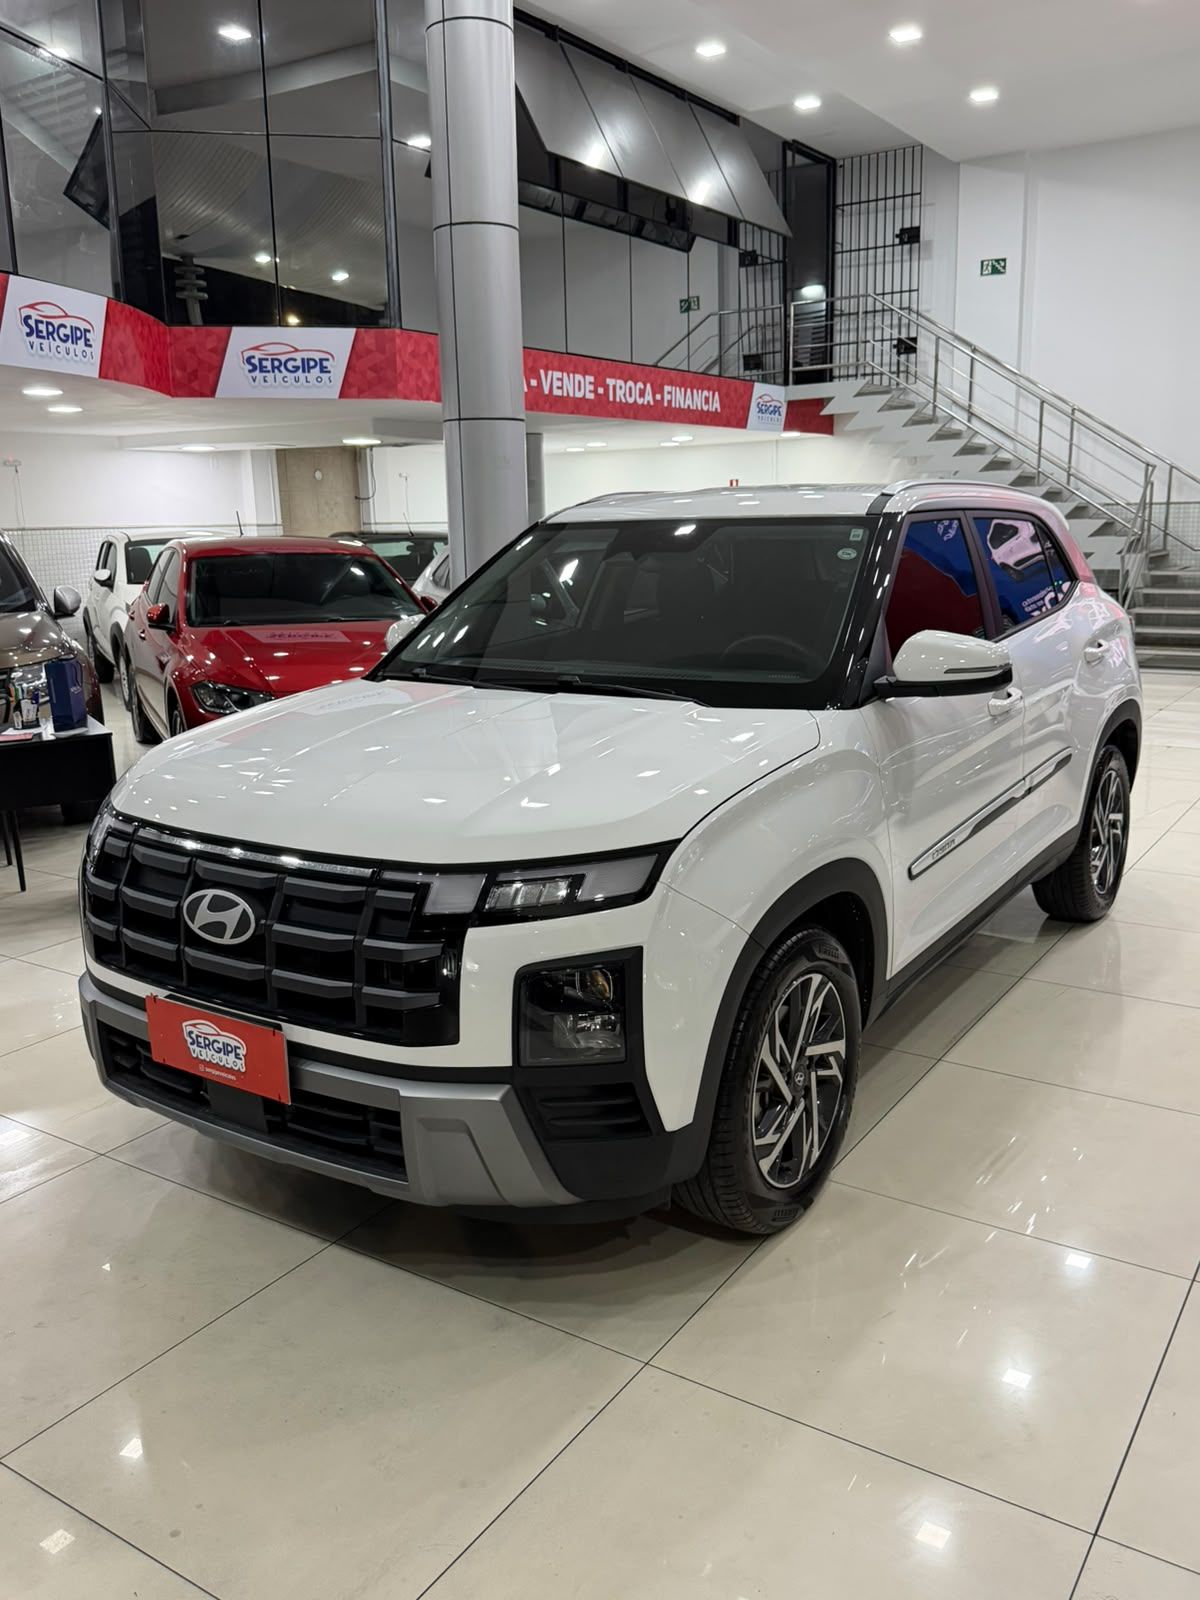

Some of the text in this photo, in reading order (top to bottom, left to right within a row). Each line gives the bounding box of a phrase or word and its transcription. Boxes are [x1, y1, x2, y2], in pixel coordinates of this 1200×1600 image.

[23, 314, 93, 348] SERGIPE
[245, 355, 331, 374] SERGIPE
[539, 369, 594, 400] VENDE
[606, 378, 654, 406] TROCA
[663, 385, 720, 413] FINANCIA
[188, 1030, 242, 1060] SERGIPE
